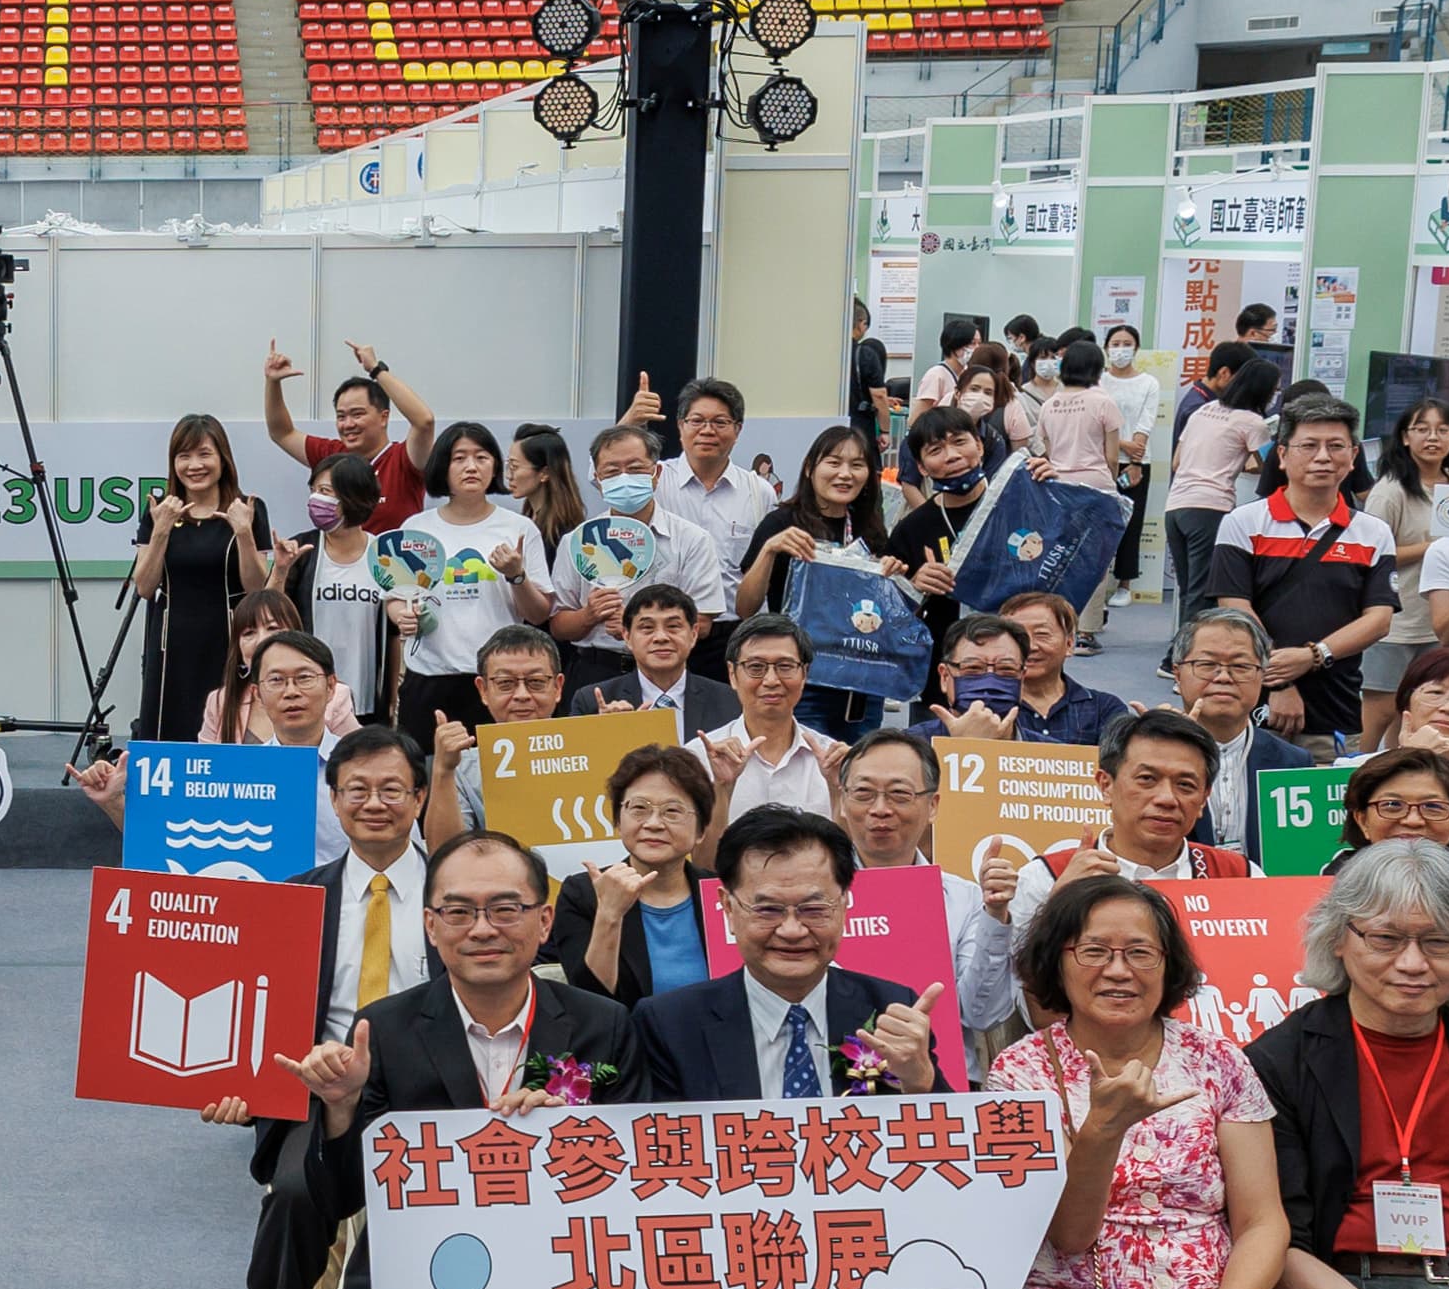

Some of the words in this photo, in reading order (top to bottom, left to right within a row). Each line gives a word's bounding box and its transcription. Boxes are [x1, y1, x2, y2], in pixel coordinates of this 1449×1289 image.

[1026, 203, 1077, 233] 國立臺灣
[528, 733, 564, 754] ZERO
[185, 758, 212, 777] LIFE
[492, 738, 517, 780] 2
[530, 752, 589, 775] HUNGER
[998, 756, 1095, 777] RESPONSIBLE
[135, 756, 173, 797] 14
[944, 753, 985, 793] 12
[185, 779, 226, 799] BELOW
[233, 781, 277, 802] WATER
[999, 779, 1104, 801] CONSUMPTION
[1000, 802, 1029, 819] AND
[1270, 786, 1313, 827] 15
[1328, 809, 1348, 826] ON
[104, 888, 132, 935] 4
[149, 890, 219, 916] QUALITY
[1184, 895, 1209, 912] NO
[147, 918, 239, 946] EDUCATION
[1190, 919, 1268, 936] POVERTY
[372, 1098, 1058, 1211] 社會參與跨校共學
[1390, 1214, 1429, 1226] VVIP
